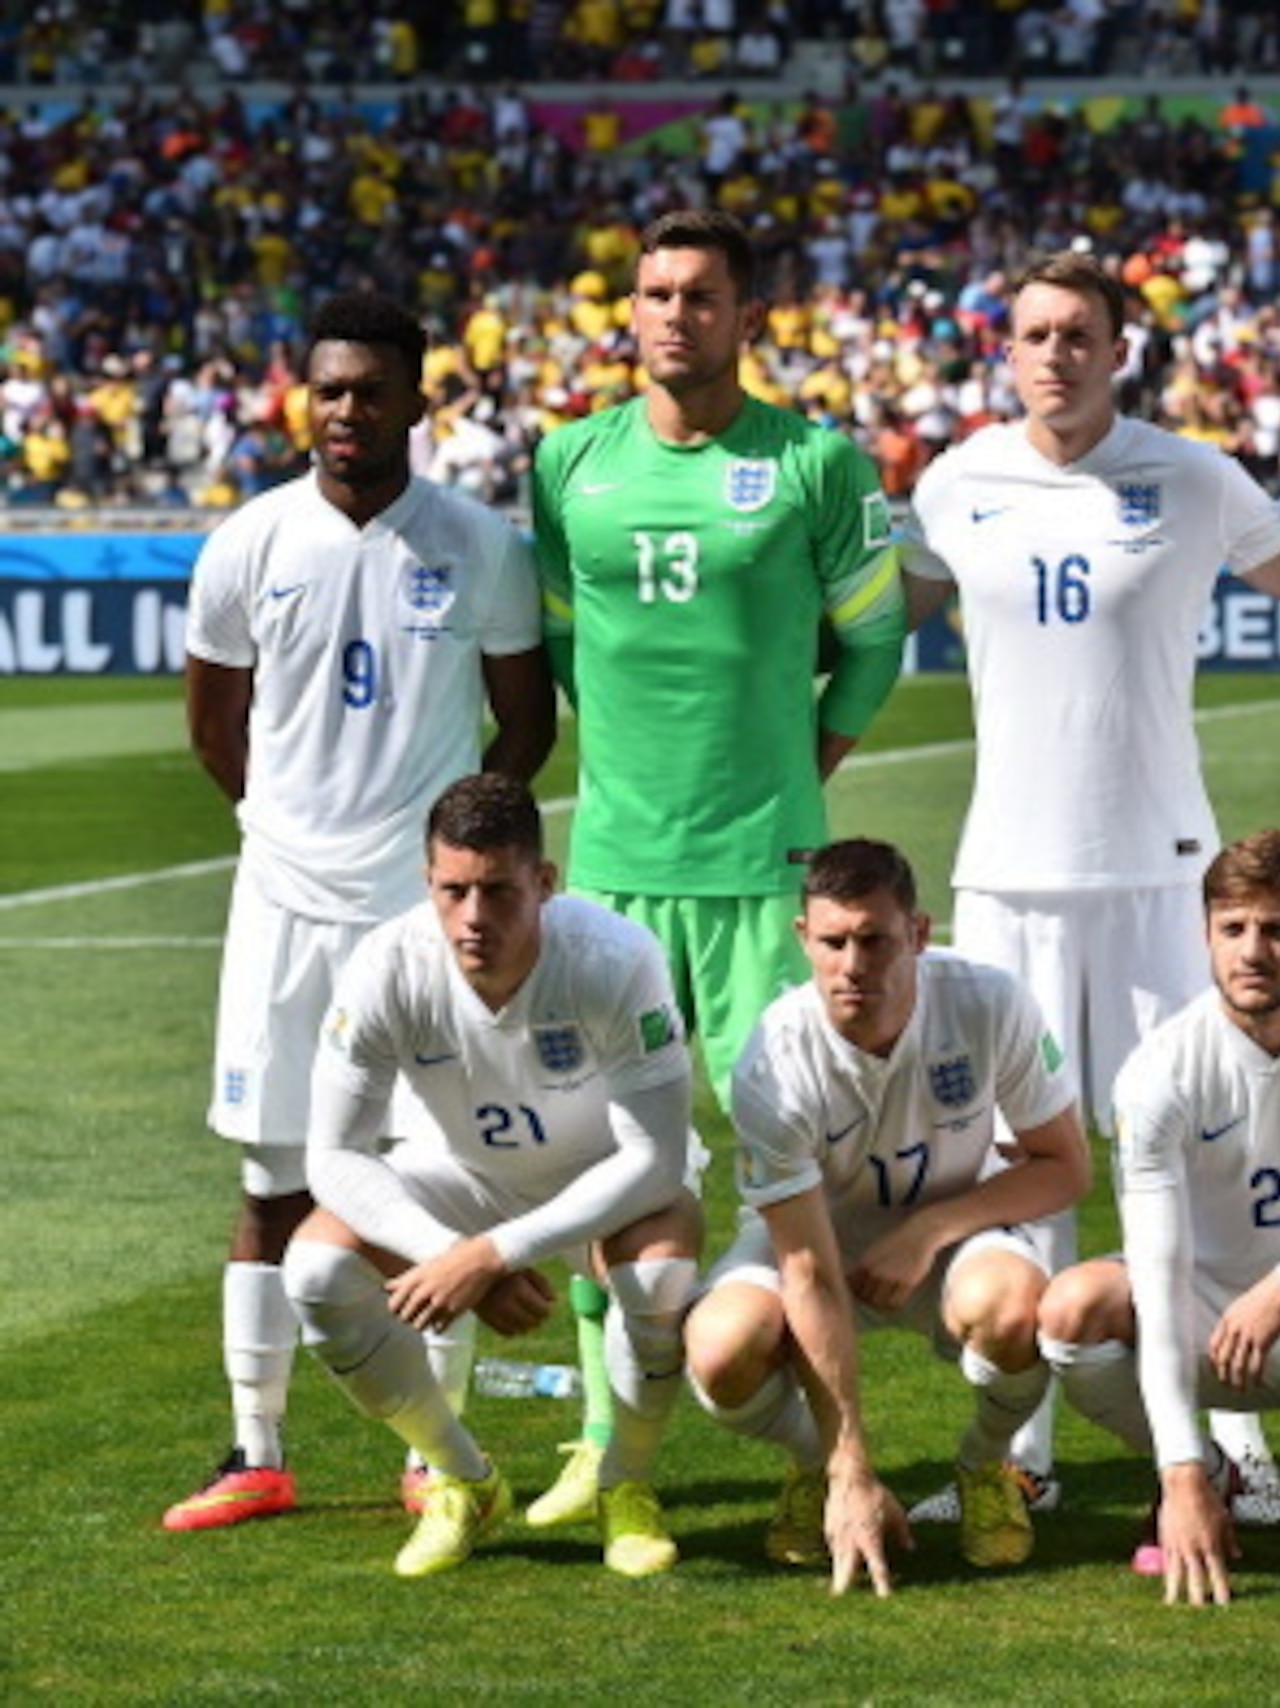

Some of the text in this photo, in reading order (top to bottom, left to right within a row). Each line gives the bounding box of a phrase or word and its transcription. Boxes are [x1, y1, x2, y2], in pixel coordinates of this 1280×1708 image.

[632, 530, 702, 603] 13
[1031, 553, 1091, 626] 16
[339, 638, 379, 710] 9
[474, 1102, 548, 1149] 21
[868, 1141, 931, 1208] 17
